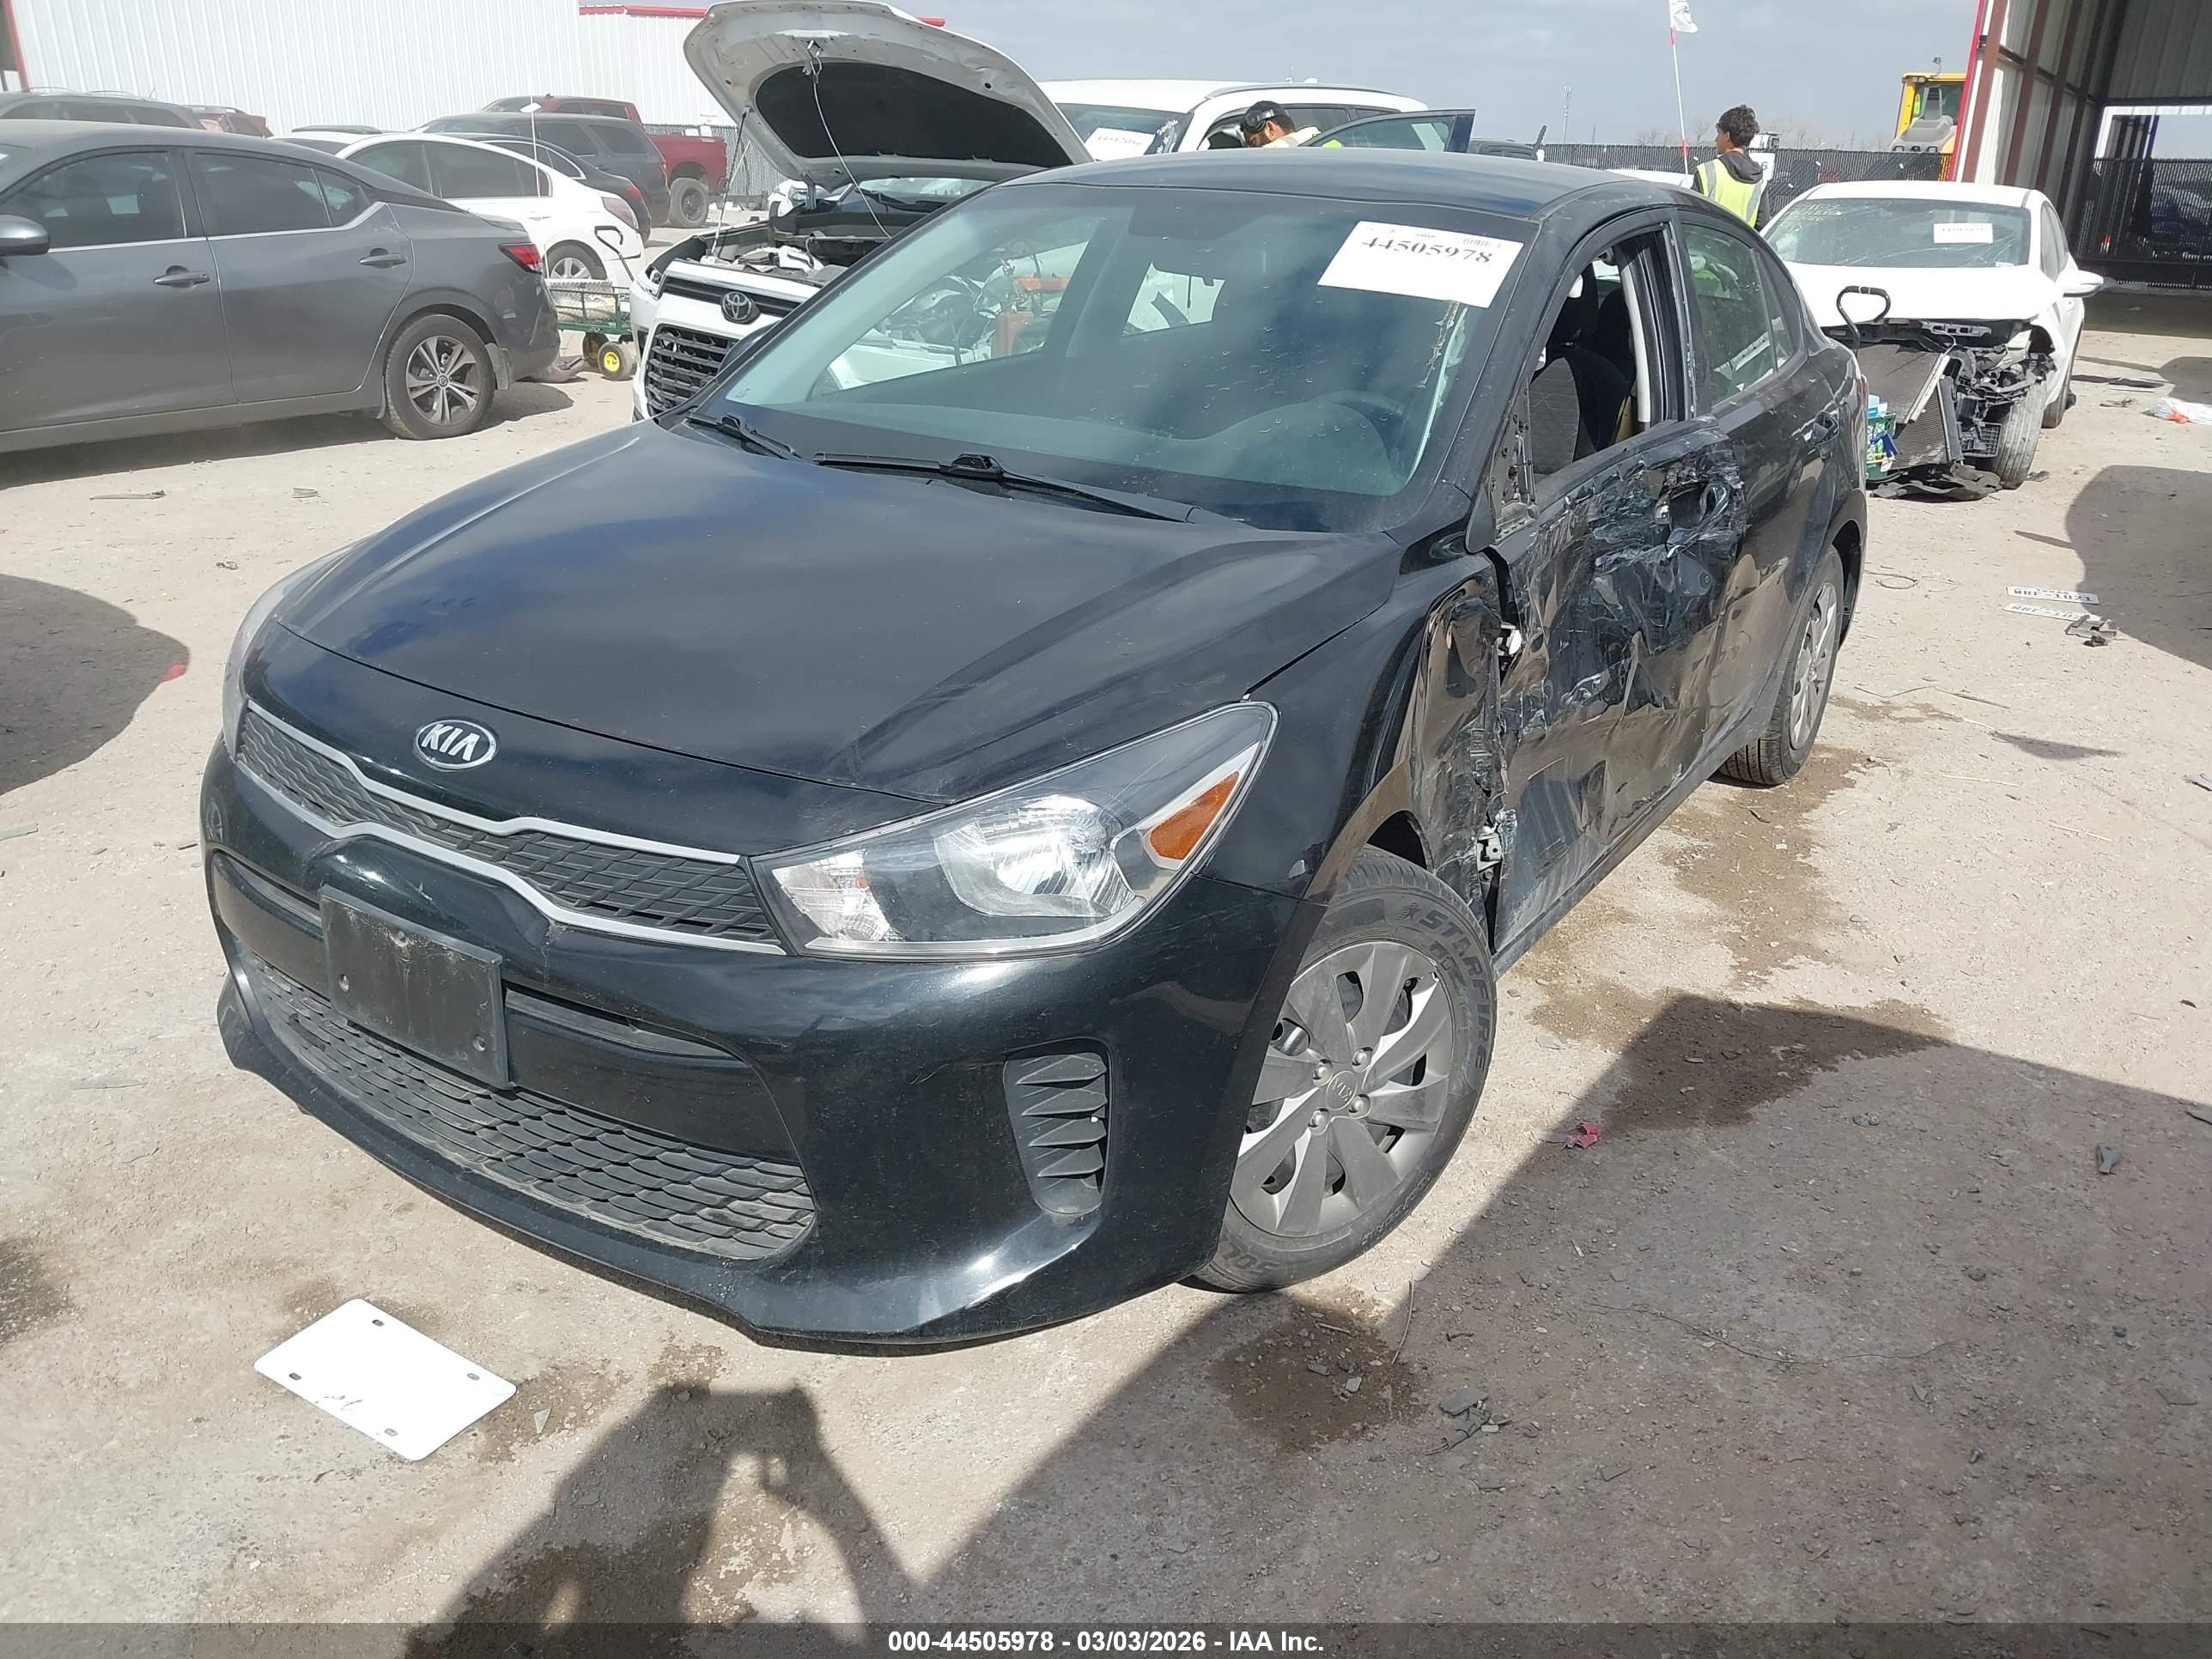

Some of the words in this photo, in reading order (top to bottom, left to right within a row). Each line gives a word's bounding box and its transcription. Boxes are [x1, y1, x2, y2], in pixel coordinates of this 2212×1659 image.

[1361, 236, 1493, 264] 44505978
[421, 724, 480, 762] KIA
[1419, 908, 1491, 1073] STARFIRE
